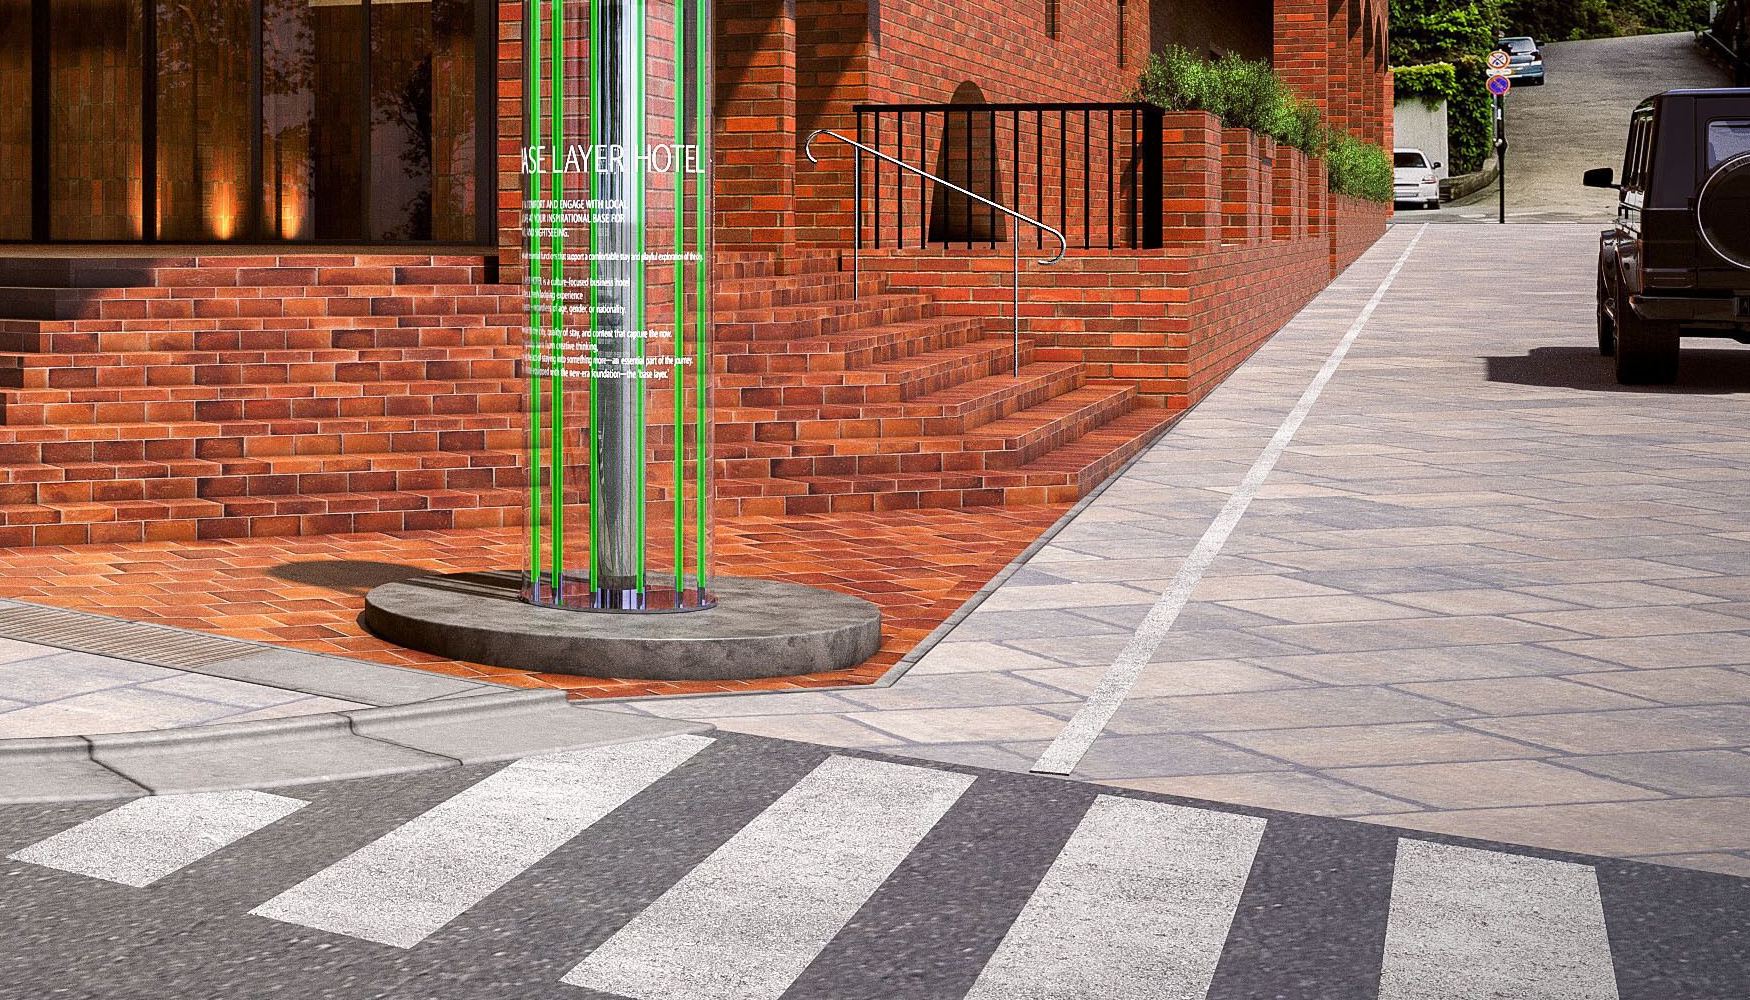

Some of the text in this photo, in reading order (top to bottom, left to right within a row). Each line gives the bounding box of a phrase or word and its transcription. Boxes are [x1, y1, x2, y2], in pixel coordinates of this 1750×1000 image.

[552, 145, 625, 174] LAYER
[634, 144, 705, 174] HOTEL
[560, 200, 585, 210] ENGAGE
[586, 200, 603, 209] WITH
[605, 200, 627, 209] LOCAL
[547, 213, 591, 223] INSPIRATIONAL
[593, 214, 609, 223] BASE
[611, 214, 625, 223] FOR
[535, 228, 569, 238] SIGHTSEEING.
[567, 253, 584, 262] support
[589, 252, 619, 261] comfortable
[590, 278, 613, 287] business
[615, 278, 630, 287] hotel
[556, 292, 583, 300] experience
[596, 304, 627, 316] nationality.
[562, 328, 568, 337] of
[582, 329, 591, 338] and
[592, 330, 613, 338] content
[614, 329, 625, 338] that
[627, 330, 647, 340] capture
[649, 329, 658, 338] the
[659, 330, 672, 338] now.
[567, 354, 592, 366] something
[621, 355, 645, 365] essential
[646, 357, 657, 367] part
[658, 355, 664, 365] of
[665, 356, 673, 364] the
[674, 357, 693, 367] journey.
